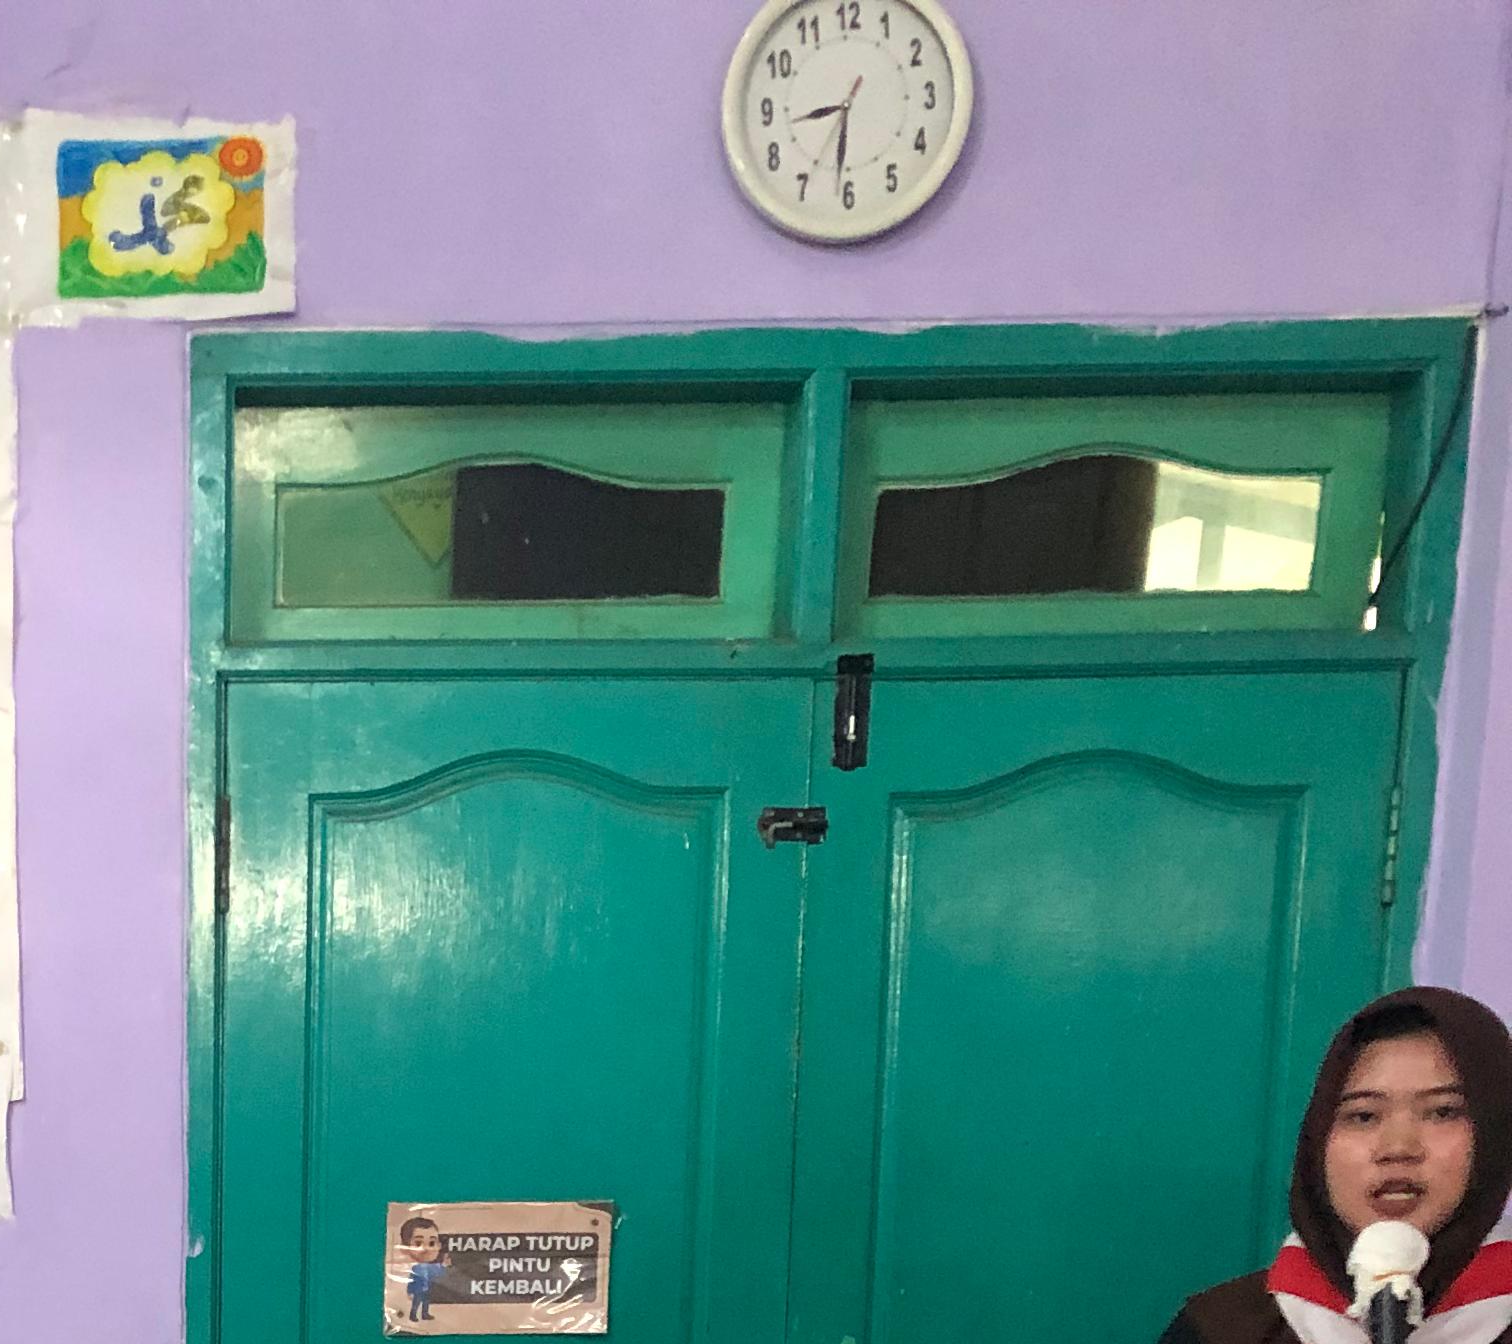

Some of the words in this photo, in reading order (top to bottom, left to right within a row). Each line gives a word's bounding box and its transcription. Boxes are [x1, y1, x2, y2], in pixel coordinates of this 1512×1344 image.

[797, 15, 820, 44] 11
[836, 2, 861, 30] 12
[880, 11, 890, 38] 1
[767, 49, 792, 78] 10
[910, 38, 922, 67] 2
[924, 81, 936, 109] 3
[761, 98, 774, 126] 9
[914, 127, 927, 155] 4
[768, 142, 780, 171] 8
[796, 173, 808, 201] 7
[886, 164, 898, 192] 5
[842, 181, 855, 209] 6
[448, 1236, 520, 1252] HARAP
[526, 1236, 594, 1251] TUTUP
[489, 1257, 551, 1273] PINTU
[470, 1279, 562, 1295] KEMBALI
